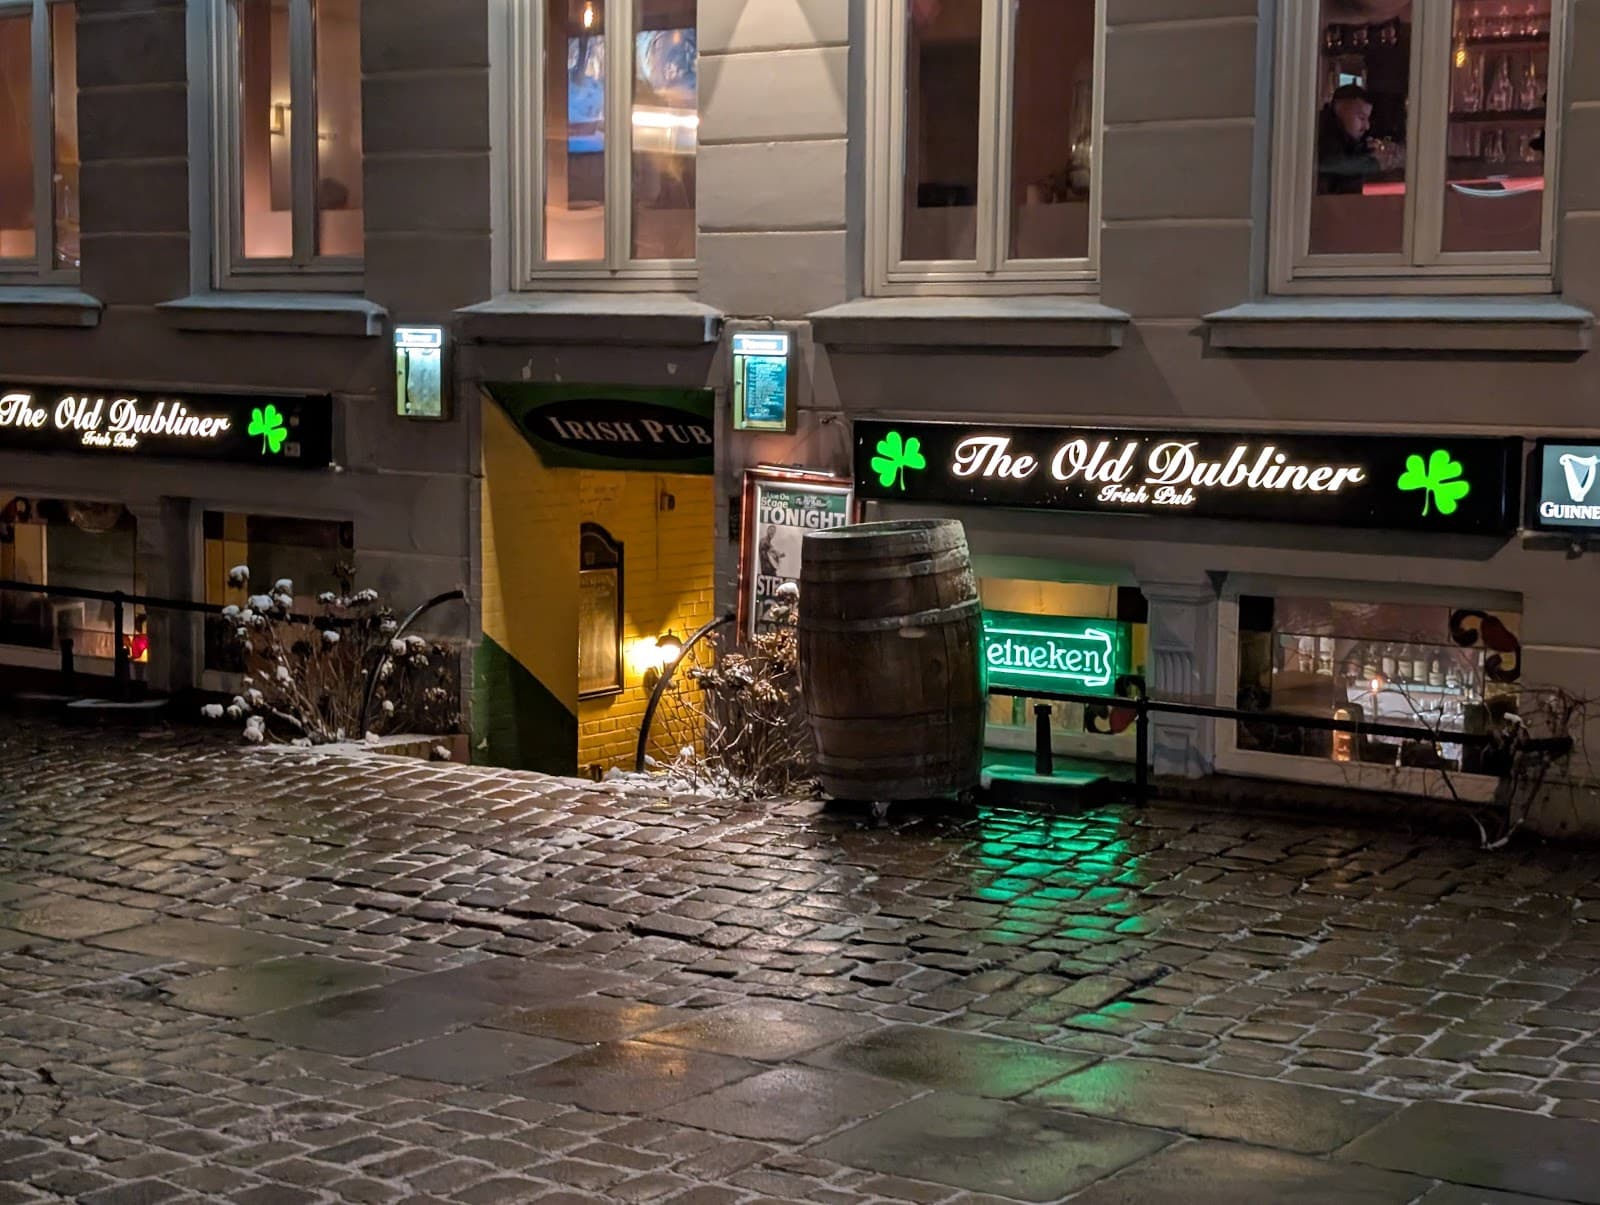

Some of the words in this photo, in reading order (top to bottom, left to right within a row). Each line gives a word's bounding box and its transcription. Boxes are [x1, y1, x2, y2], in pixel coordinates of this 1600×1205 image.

[0, 394, 47, 428] The
[54, 396, 104, 430] Old
[107, 399, 231, 437] Dubliner
[81, 431, 112, 446] Irish
[112, 432, 138, 448] Pub
[547, 416, 641, 442] IRISH
[952, 436, 1039, 479] The
[1051, 438, 1138, 483] Old
[1146, 441, 1367, 493] Dubliner
[761, 496, 789, 509] Stage
[1097, 485, 1149, 503] Irish
[1151, 487, 1196, 506] Pub
[760, 506, 845, 529] TONIGHT
[757, 575, 784, 597] STE
[985, 638, 1103, 674] eineken
